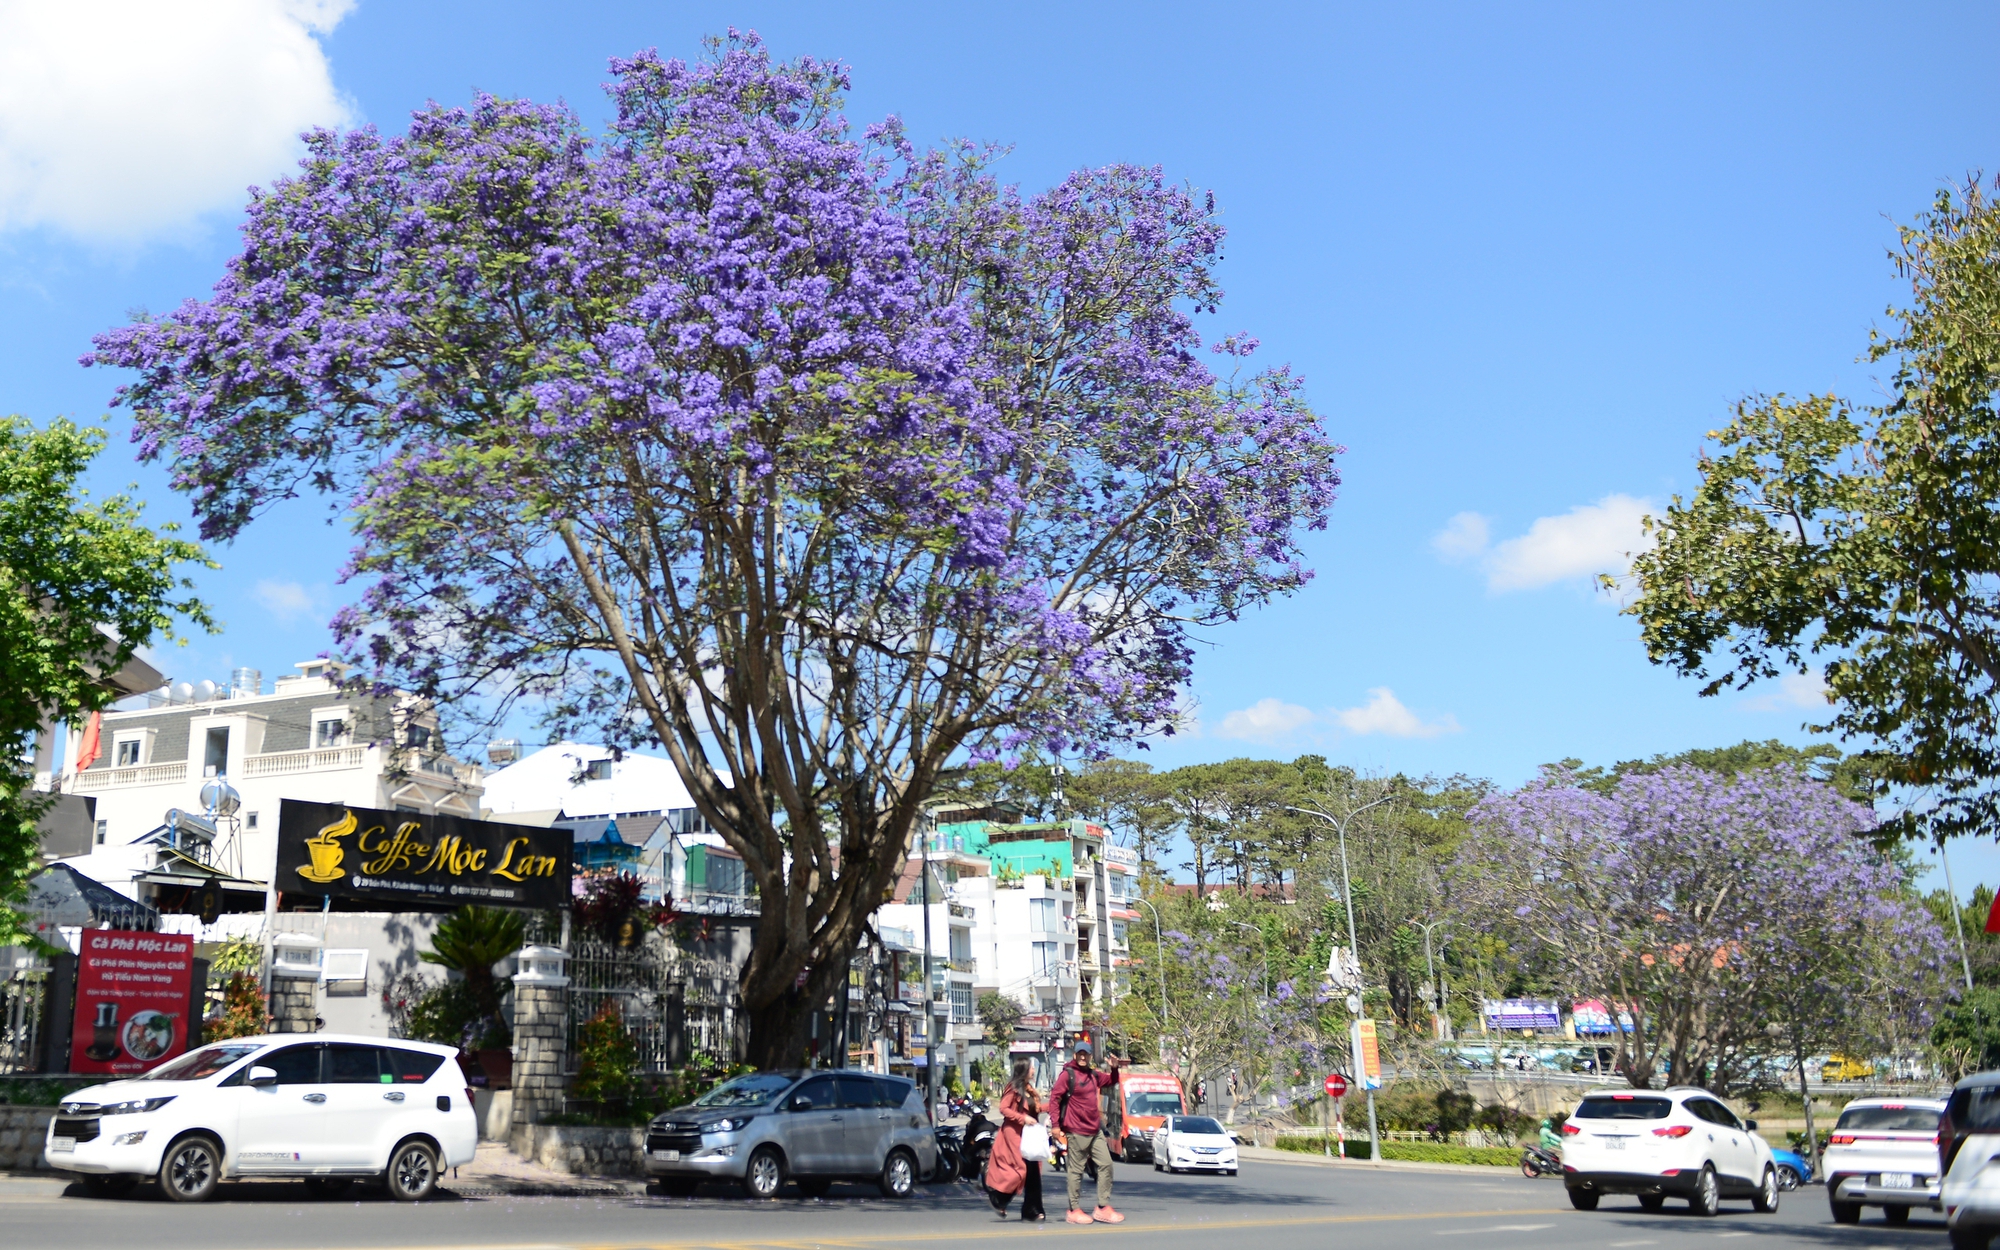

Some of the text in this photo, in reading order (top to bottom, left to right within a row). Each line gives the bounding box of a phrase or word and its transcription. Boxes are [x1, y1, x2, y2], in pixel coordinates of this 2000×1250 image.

[358, 820, 556, 882] Coffee Mộc Lan
[91, 937, 187, 953] Cà Phê Mộc Lan
[89, 958, 186, 970] Cà Phê Phin Nguyên Chất
[133, 973, 150, 982] Nam
[153, 974, 172, 984] Vang
